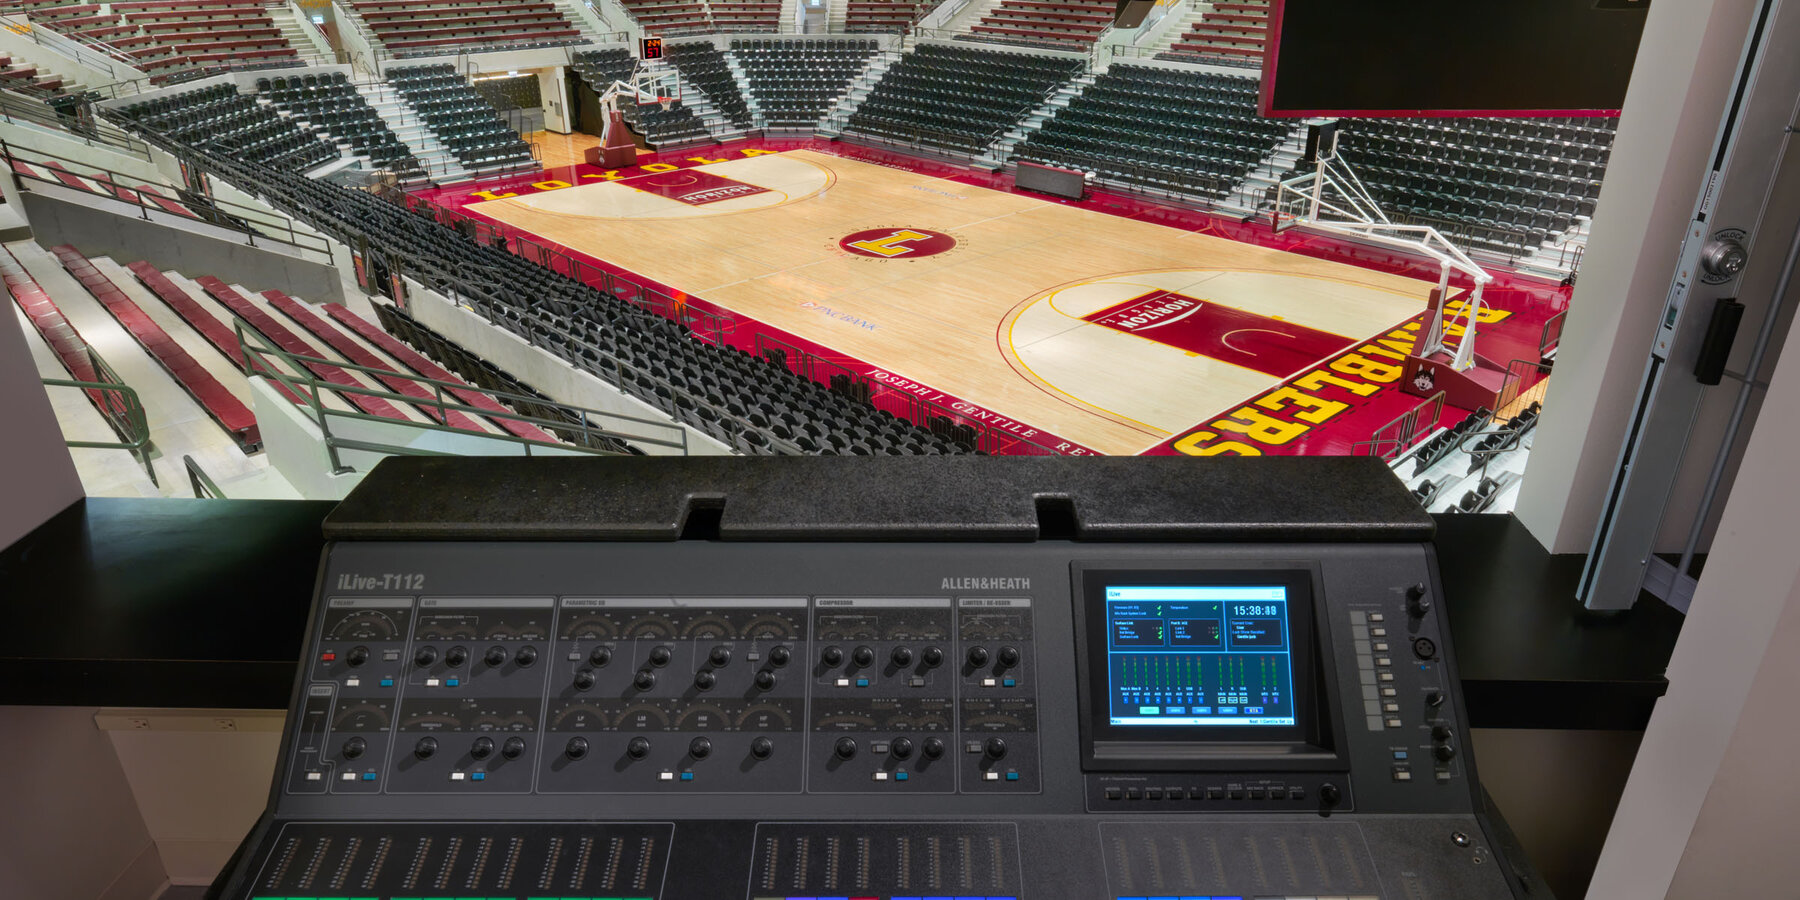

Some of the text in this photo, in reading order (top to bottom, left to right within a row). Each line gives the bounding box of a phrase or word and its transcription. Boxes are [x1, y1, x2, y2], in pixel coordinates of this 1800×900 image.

[647, 47, 659, 58] 57
[470, 147, 780, 201] LOYOLA
[847, 228, 934, 258] L
[1715, 230, 1744, 242] UNLOCK
[1116, 299, 1195, 329] HORIZON
[865, 368, 930, 396] JOSEPH
[929, 394, 943, 403] J.
[950, 400, 1039, 439] GENTILE
[337, 573, 425, 590] iLive-T112
[941, 577, 1031, 590] ALLEN&HEATH
